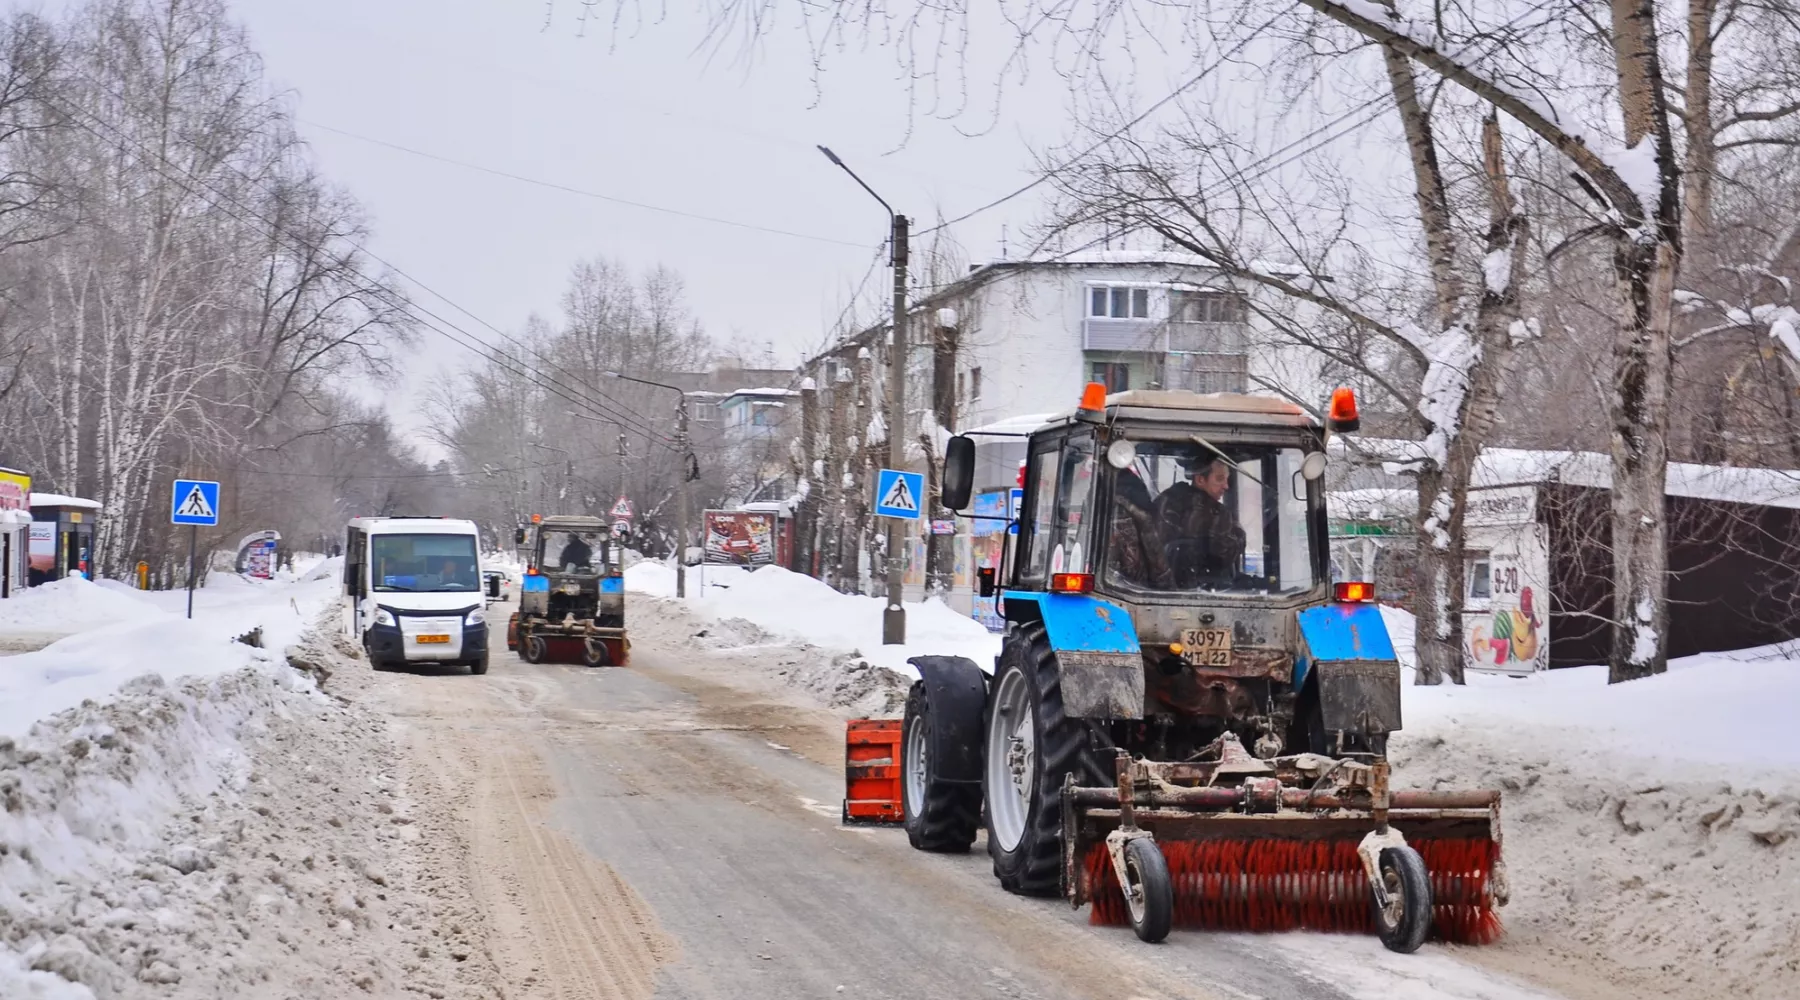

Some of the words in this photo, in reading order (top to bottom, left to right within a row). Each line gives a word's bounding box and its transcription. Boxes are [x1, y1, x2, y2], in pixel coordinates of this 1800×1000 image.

[1495, 567, 1518, 593] 9-20
[1187, 631, 1225, 646] 3097
[1211, 652, 1227, 664] 22
